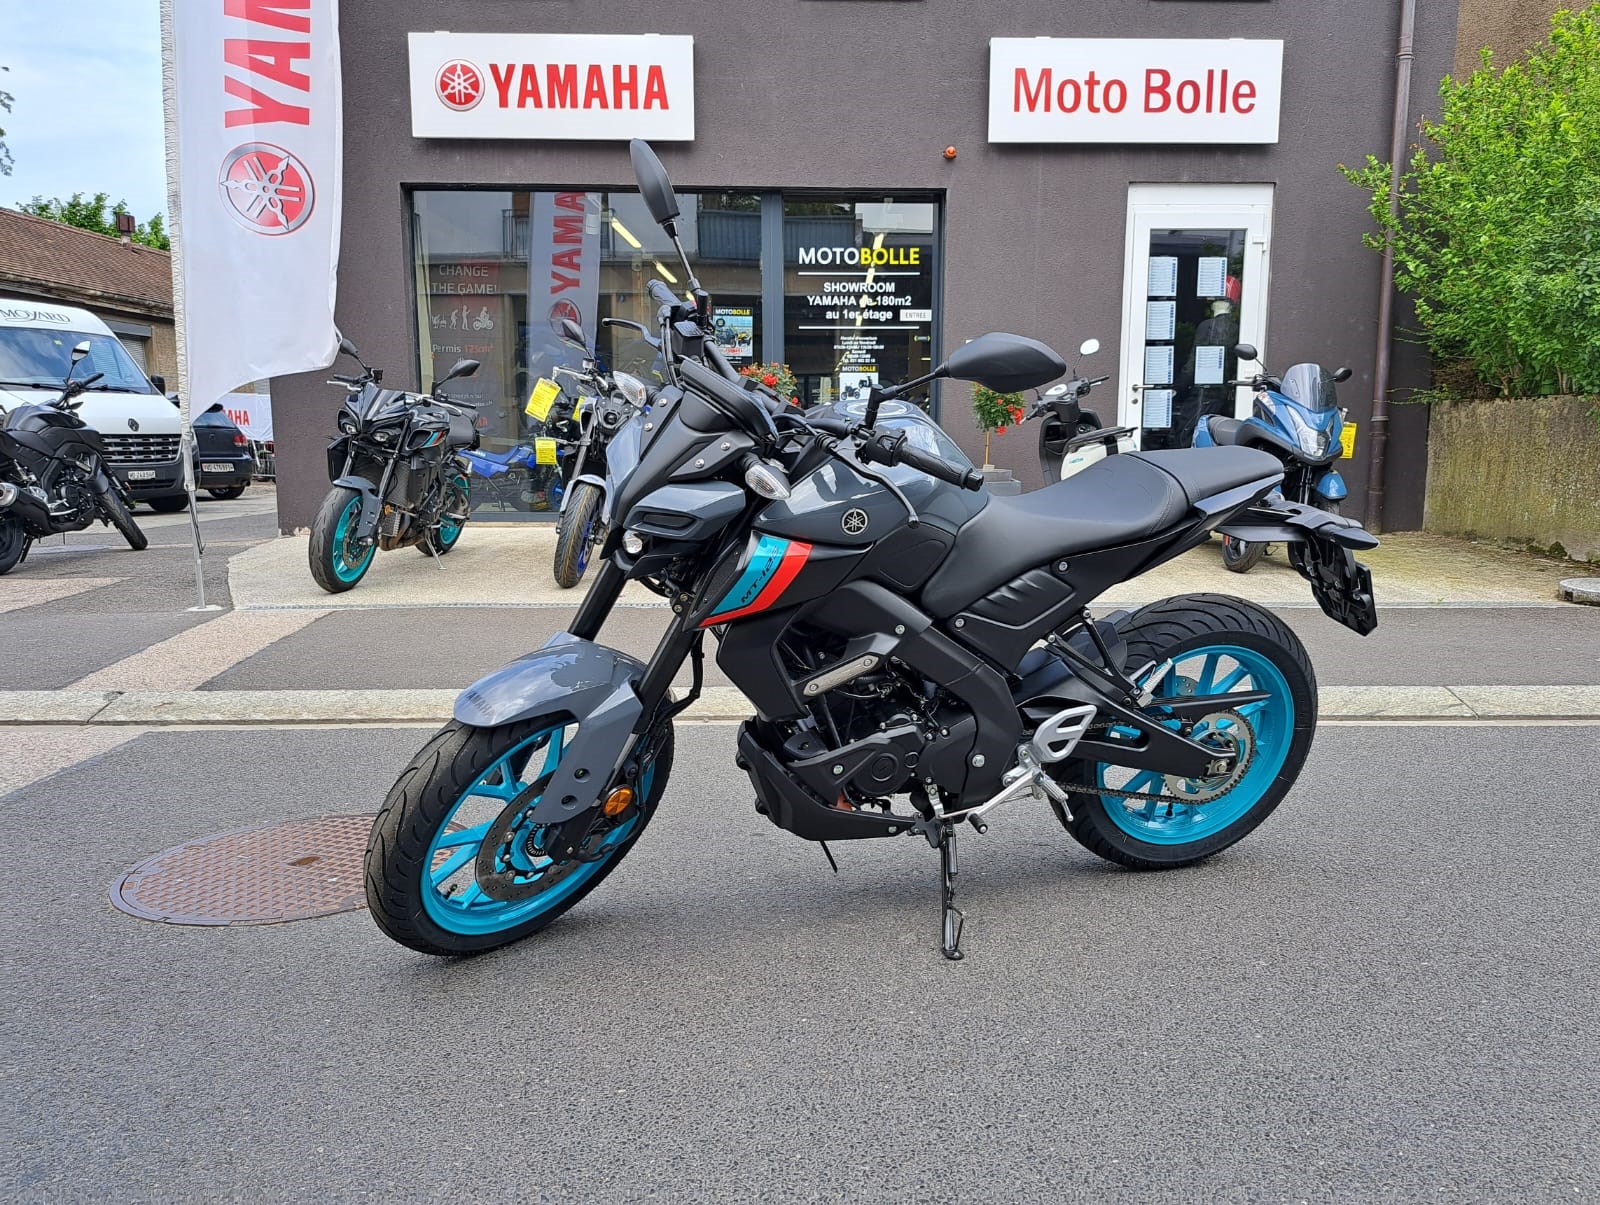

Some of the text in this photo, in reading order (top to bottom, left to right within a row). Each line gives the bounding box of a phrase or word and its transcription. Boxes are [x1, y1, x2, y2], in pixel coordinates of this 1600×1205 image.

[489, 63, 670, 110] YAMAHA
[1013, 67, 1257, 114] Moto Bolle
[798, 247, 920, 265] MOTOBOLLE
[439, 265, 489, 277] CHANGE
[432, 282, 497, 295] THE GAME!
[823, 282, 895, 293] SHOWROOM
[807, 296, 857, 306] YAMAHA
[876, 296, 912, 306] 180m2
[825, 309, 893, 321] au 1er étage
[432, 343, 462, 353] Permis
